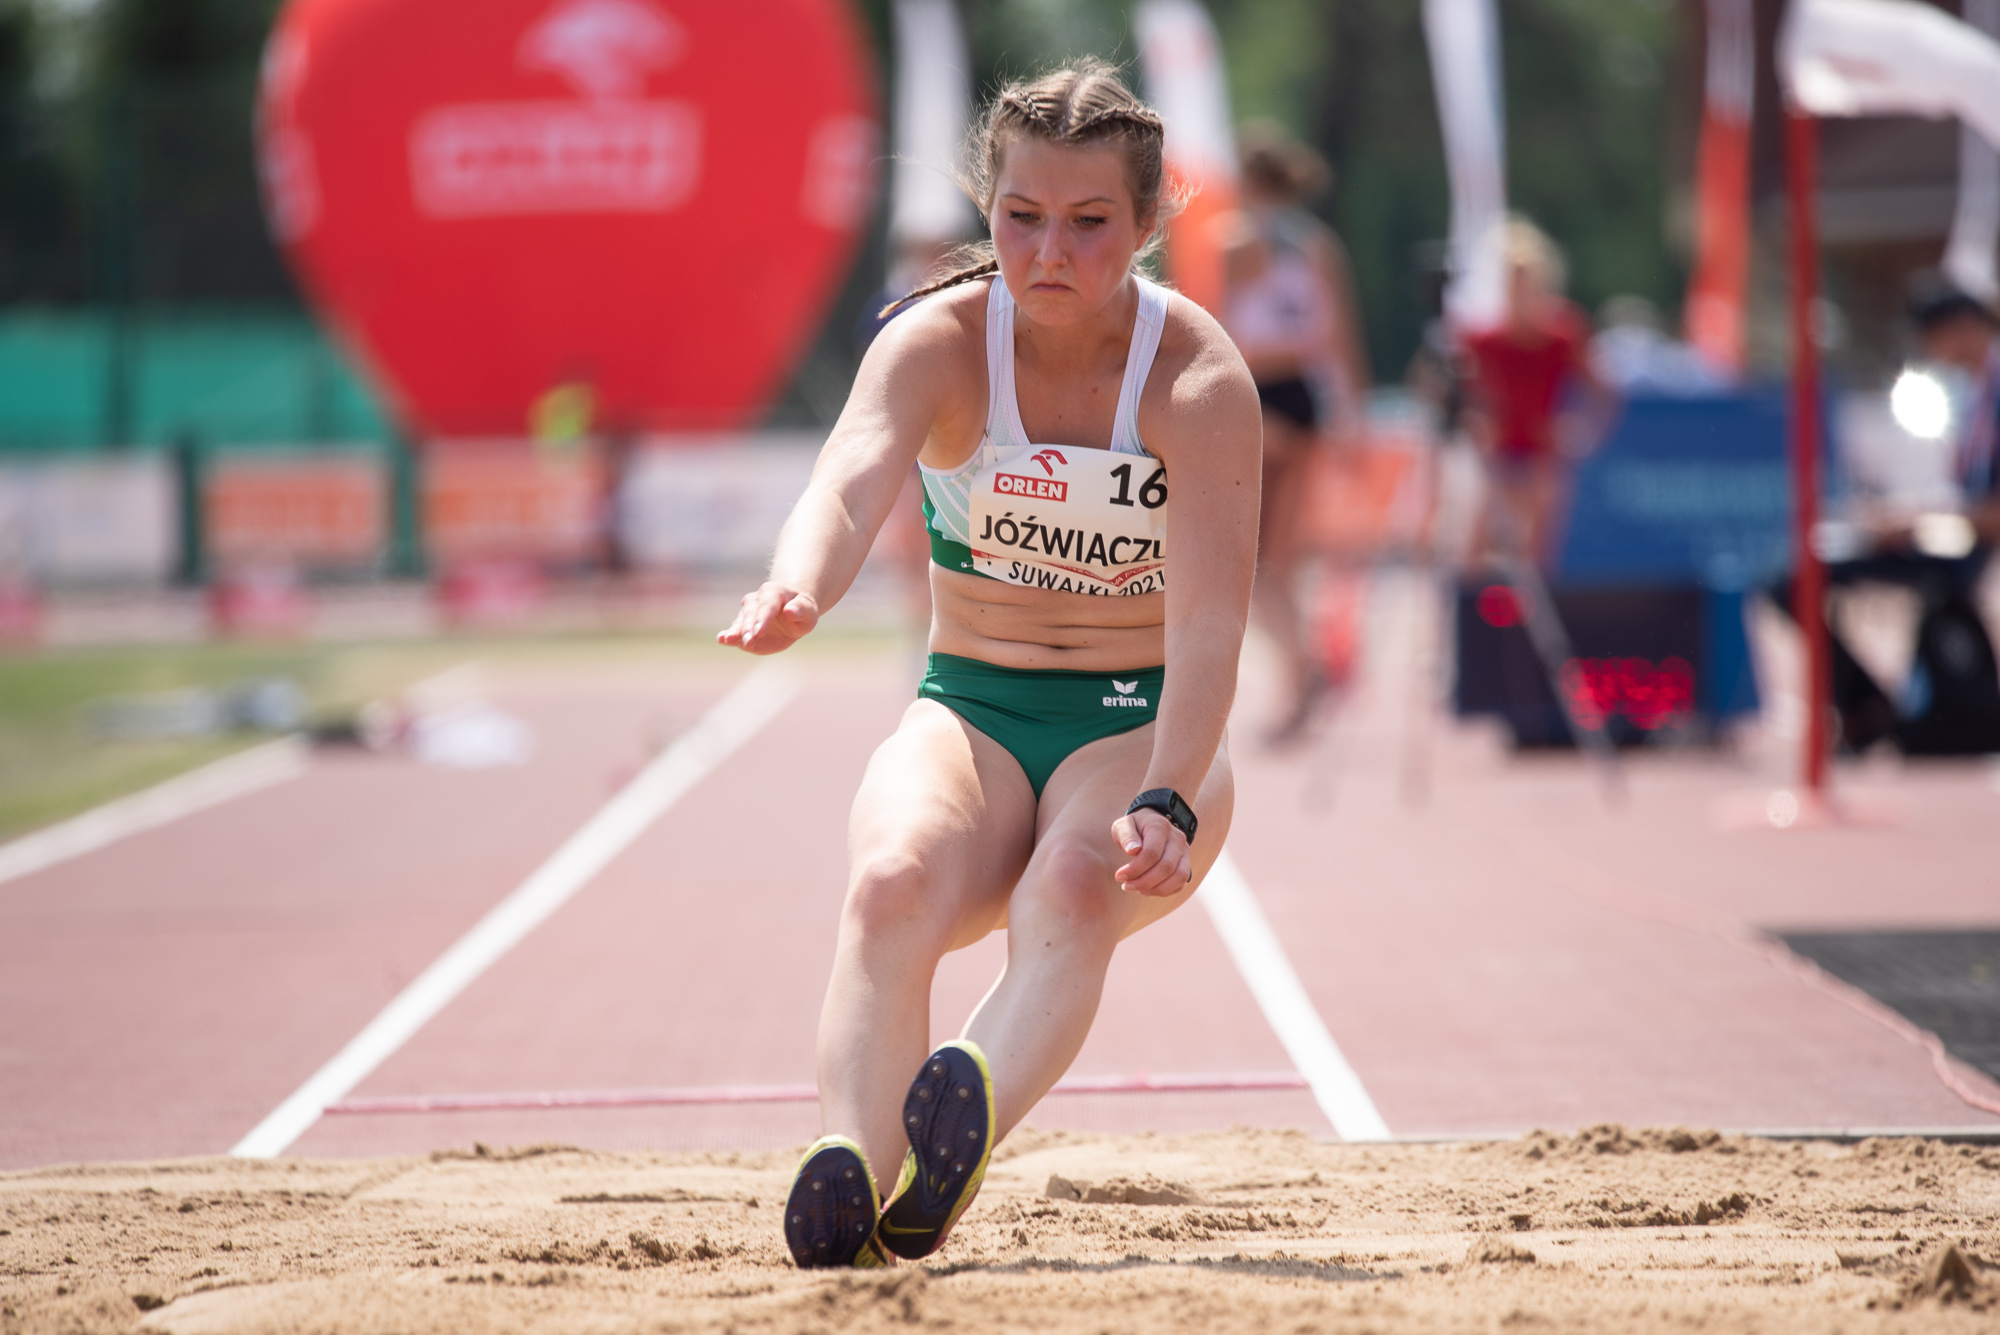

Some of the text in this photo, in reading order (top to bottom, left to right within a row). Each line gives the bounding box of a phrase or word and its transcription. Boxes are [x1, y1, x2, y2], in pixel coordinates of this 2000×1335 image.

[997, 475, 1064, 500] ORLEN
[1109, 463, 1168, 510] 16
[1102, 694, 1148, 707] erima
